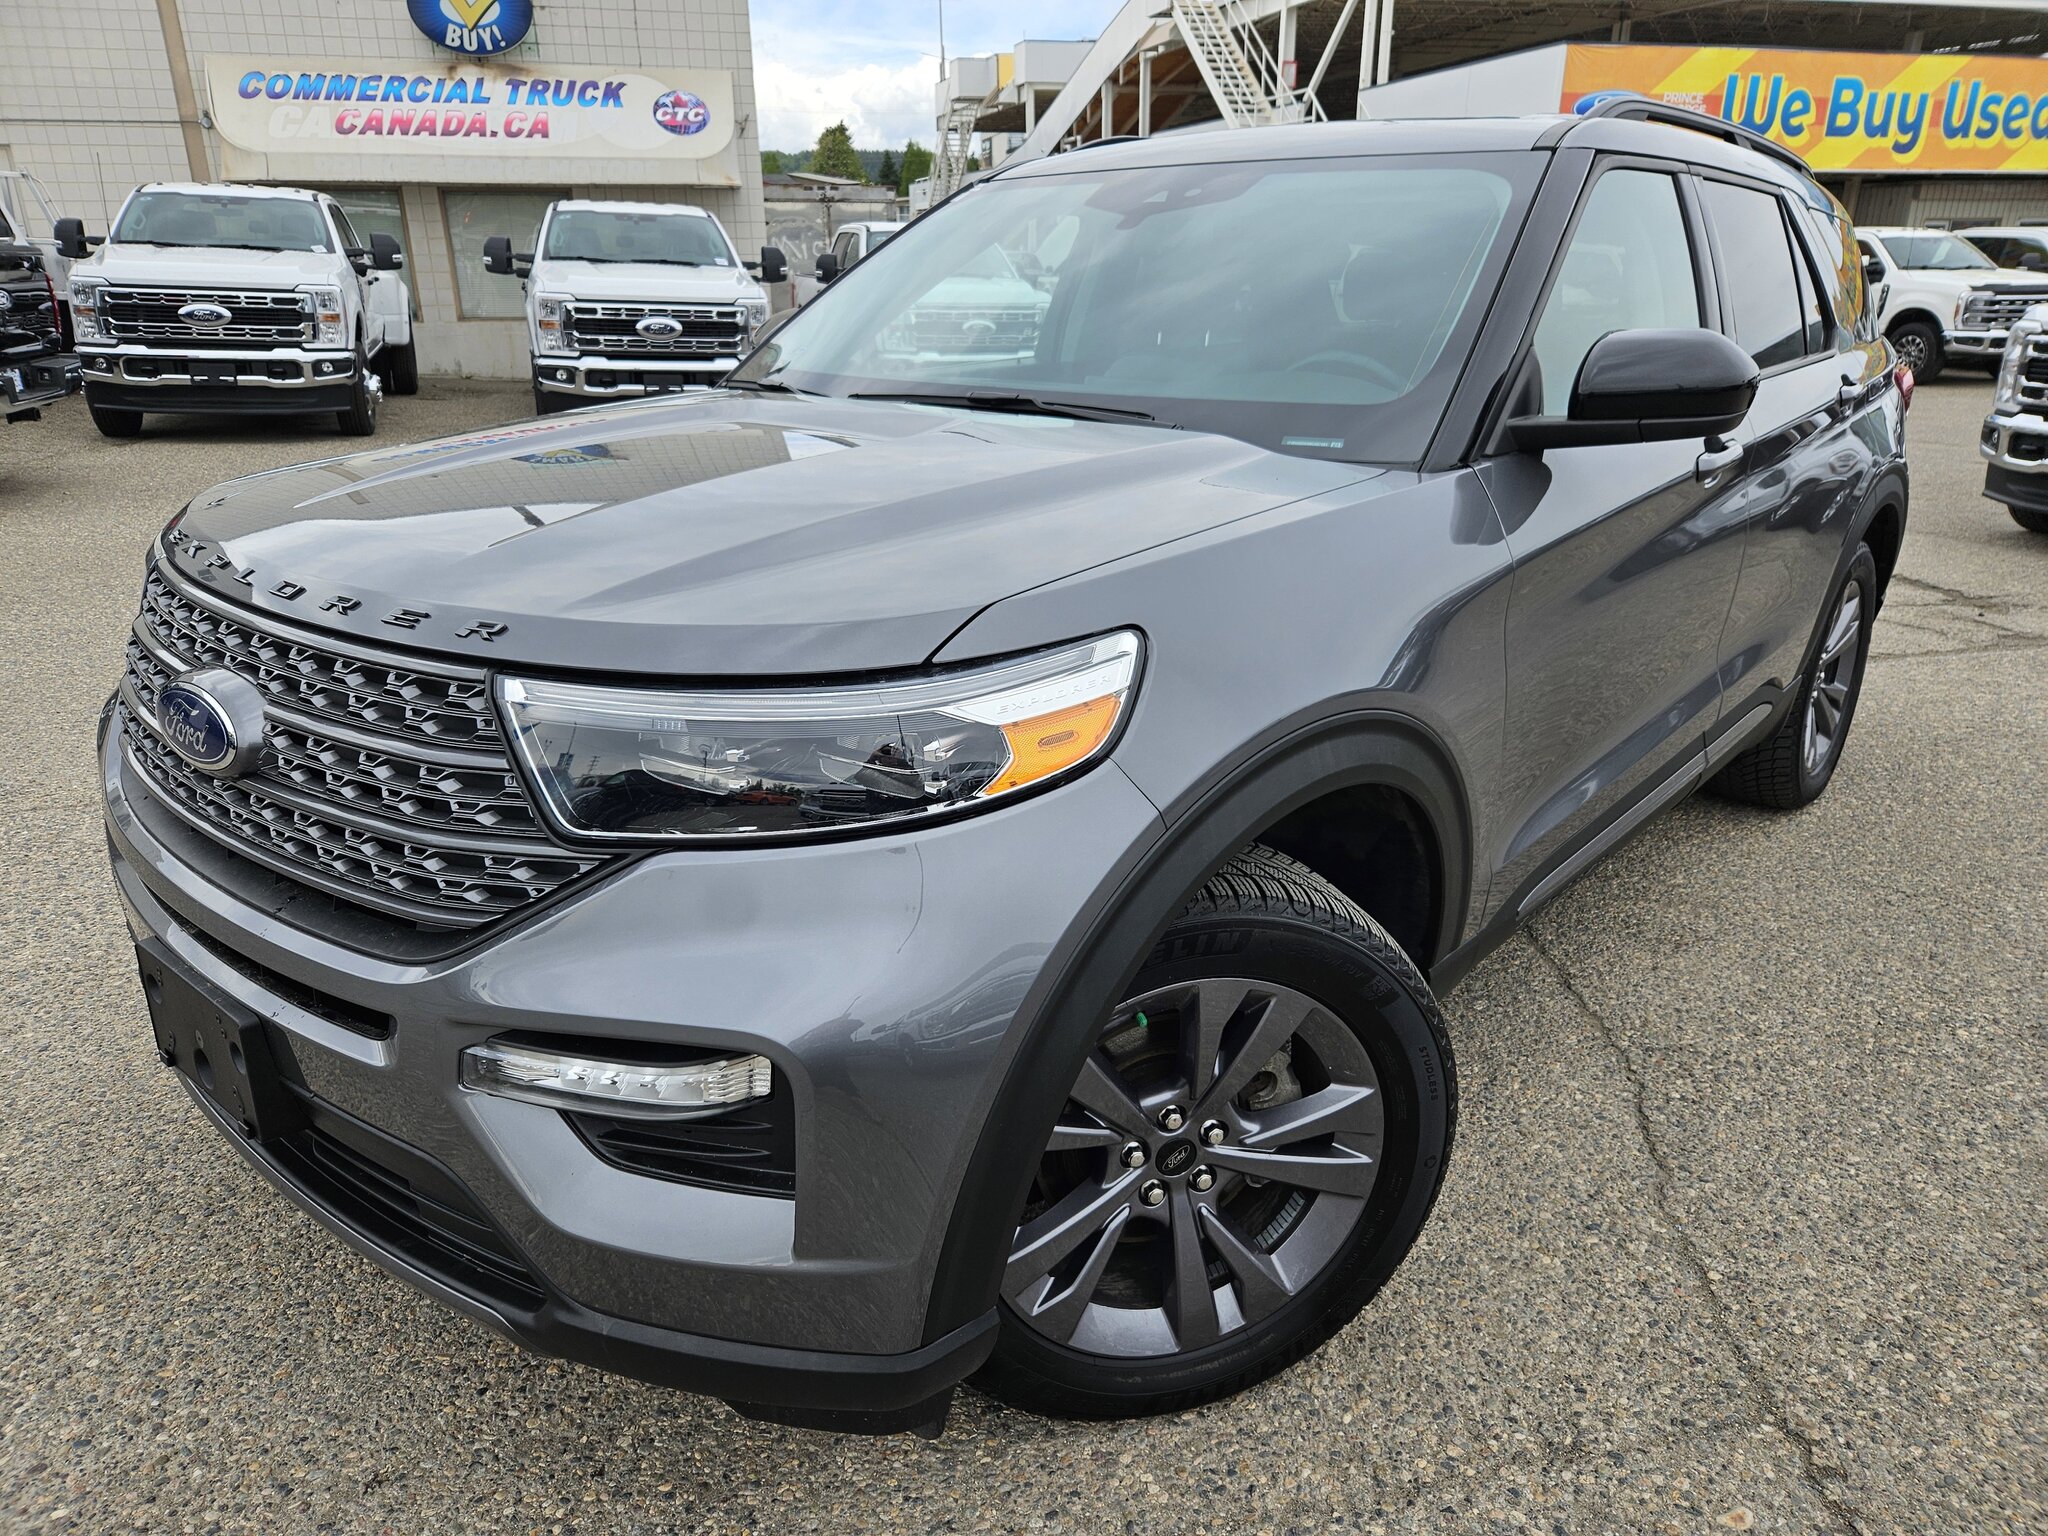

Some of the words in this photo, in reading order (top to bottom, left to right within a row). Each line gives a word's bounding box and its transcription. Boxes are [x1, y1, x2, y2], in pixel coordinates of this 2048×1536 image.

[445, 22, 506, 51] BUY!
[238, 70, 491, 104] COMMERCIAL
[505, 77, 627, 108] TRUCK
[1663, 92, 1705, 105] PRINCE
[335, 108, 549, 138] CANADA.CA
[656, 106, 705, 122] CTC
[1722, 72, 1812, 137] We
[1825, 76, 1930, 155] Buy
[193, 309, 217, 321] Ford
[650, 324, 671, 334] Ford
[168, 528, 510, 643] EXPLORER
[997, 674, 1112, 715] EXPLORER
[164, 697, 210, 753] Ford
[1419, 1046, 1439, 1101] STUDLESS
[1167, 1149, 1186, 1168] Ford
